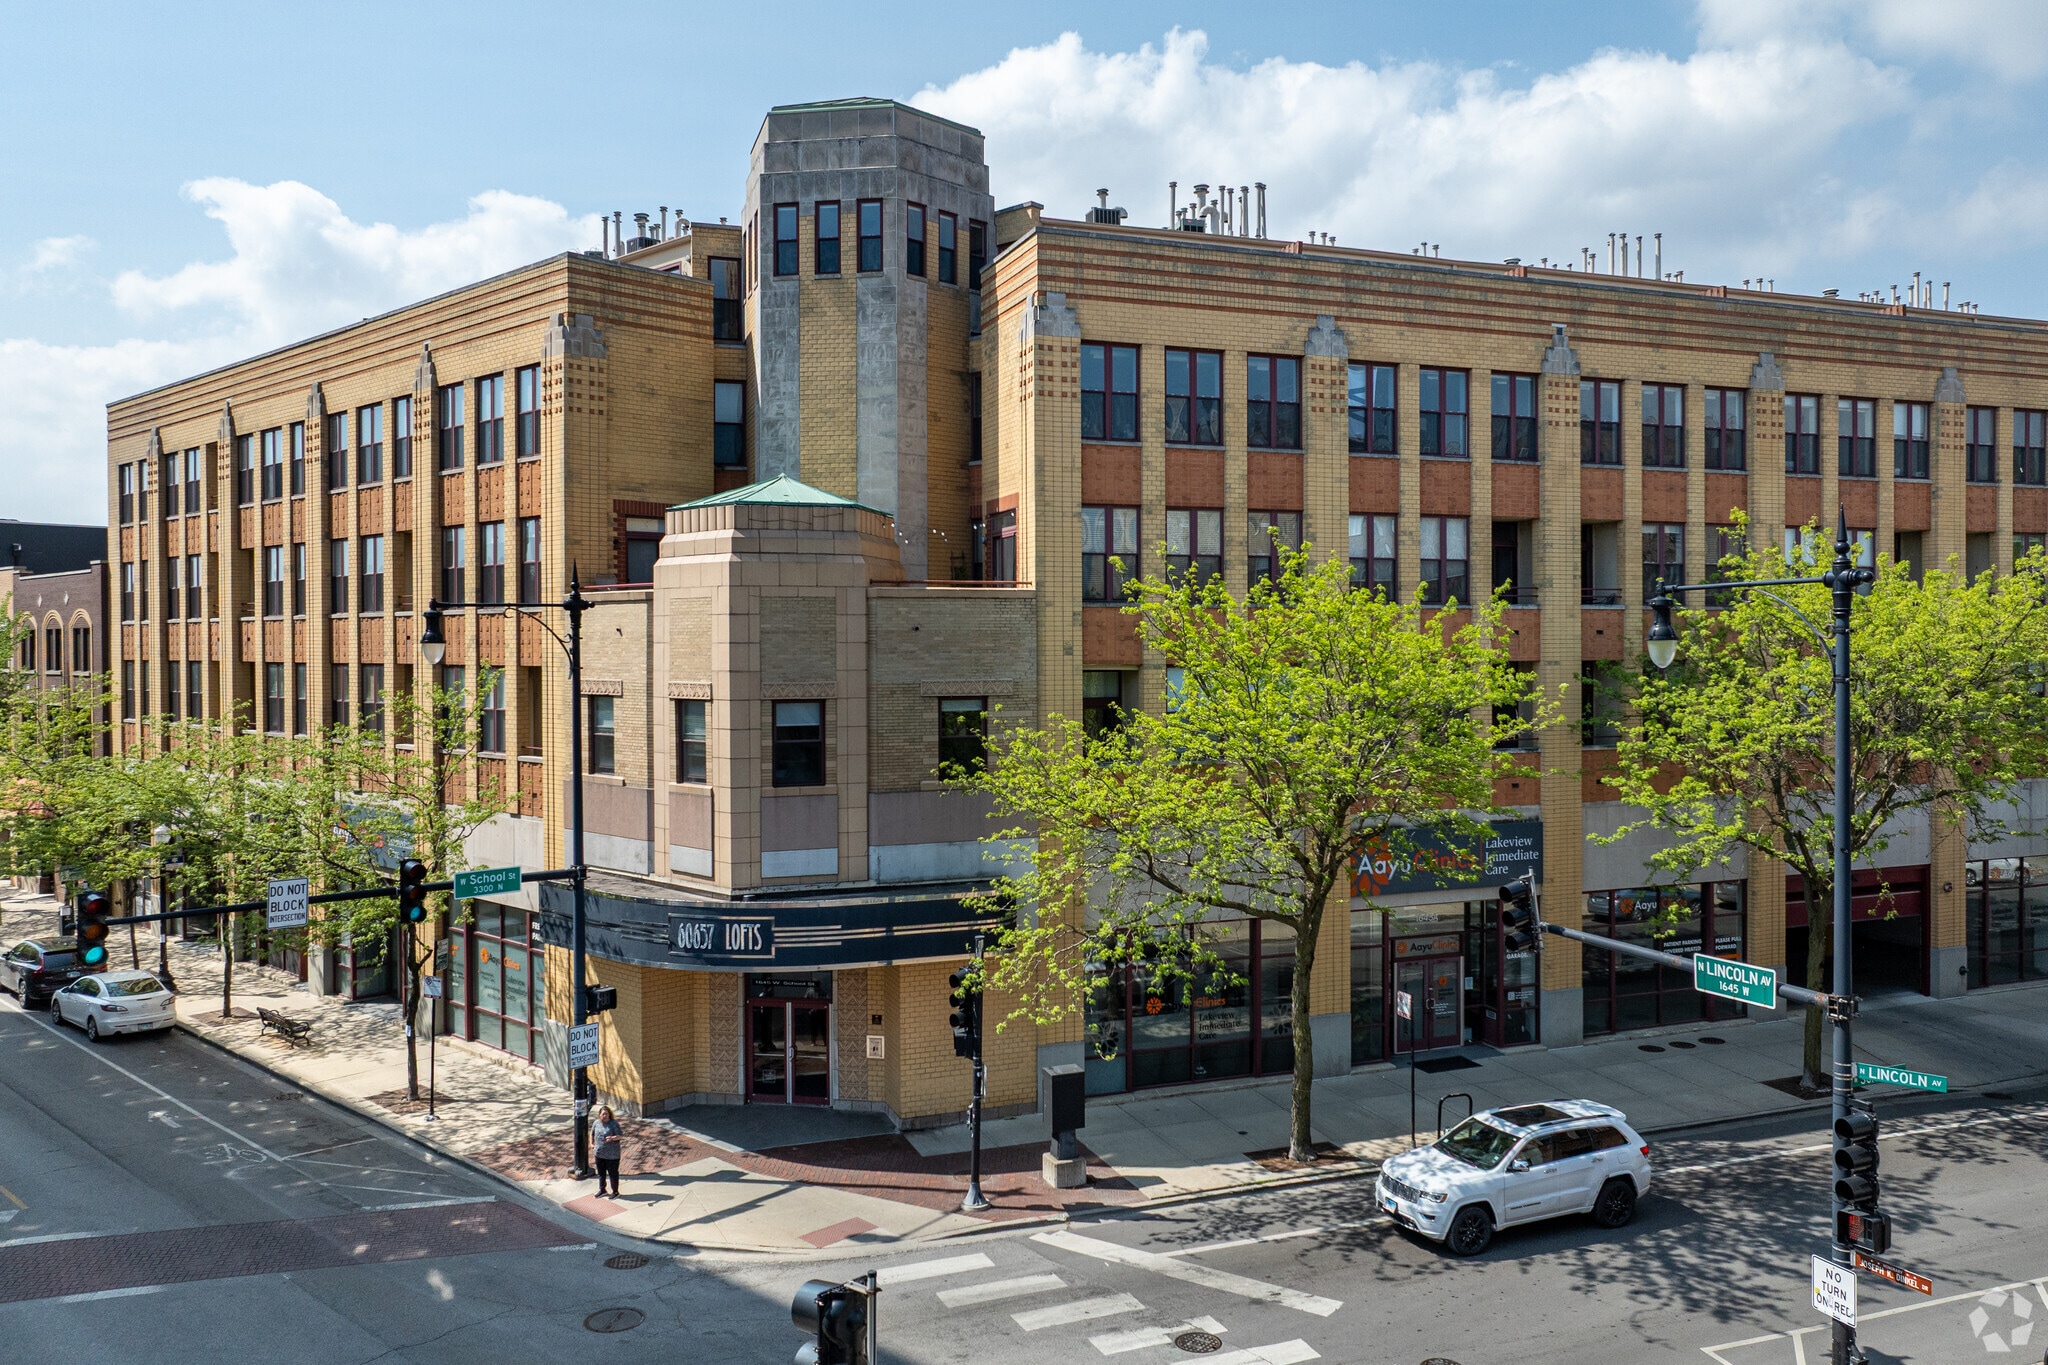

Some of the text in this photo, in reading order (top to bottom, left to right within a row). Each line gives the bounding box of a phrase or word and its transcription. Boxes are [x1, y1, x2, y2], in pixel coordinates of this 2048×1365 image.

[1486, 836, 1532, 848] Lakeview
[1486, 849, 1539, 862] Immediate
[1357, 854, 1410, 880] Aayu
[1485, 864, 1508, 875] Care
[470, 872, 506, 884] School
[271, 884, 306, 897] DO NOT
[474, 885, 493, 893] 3300
[271, 899, 304, 912] BLOCK
[1635, 900, 1657, 912] Aayu
[270, 913, 305, 923] INTERSECTION
[532, 922, 540, 930] FRE
[678, 922, 762, 950] 60657 LOFTS
[1410, 942, 1432, 952] Aayu
[1698, 962, 1771, 986] N LINCOLN AV
[1719, 981, 1750, 996] 1645 W
[1195, 996, 1226, 1008] Clinics
[1200, 1012, 1235, 1021] Lakeview
[1200, 1020, 1240, 1031] Immediate
[571, 1028, 597, 1041] DO NOT
[572, 1041, 596, 1055] BLOCK
[1868, 1066, 1928, 1087] LINCOLN
[1826, 1268, 1842, 1283] NO
[1860, 1260, 1884, 1275] JOSEPH
[1896, 1273, 1919, 1289] DINKEL
[1822, 1280, 1847, 1300] TURN
[1817, 1293, 1828, 1307] ON
